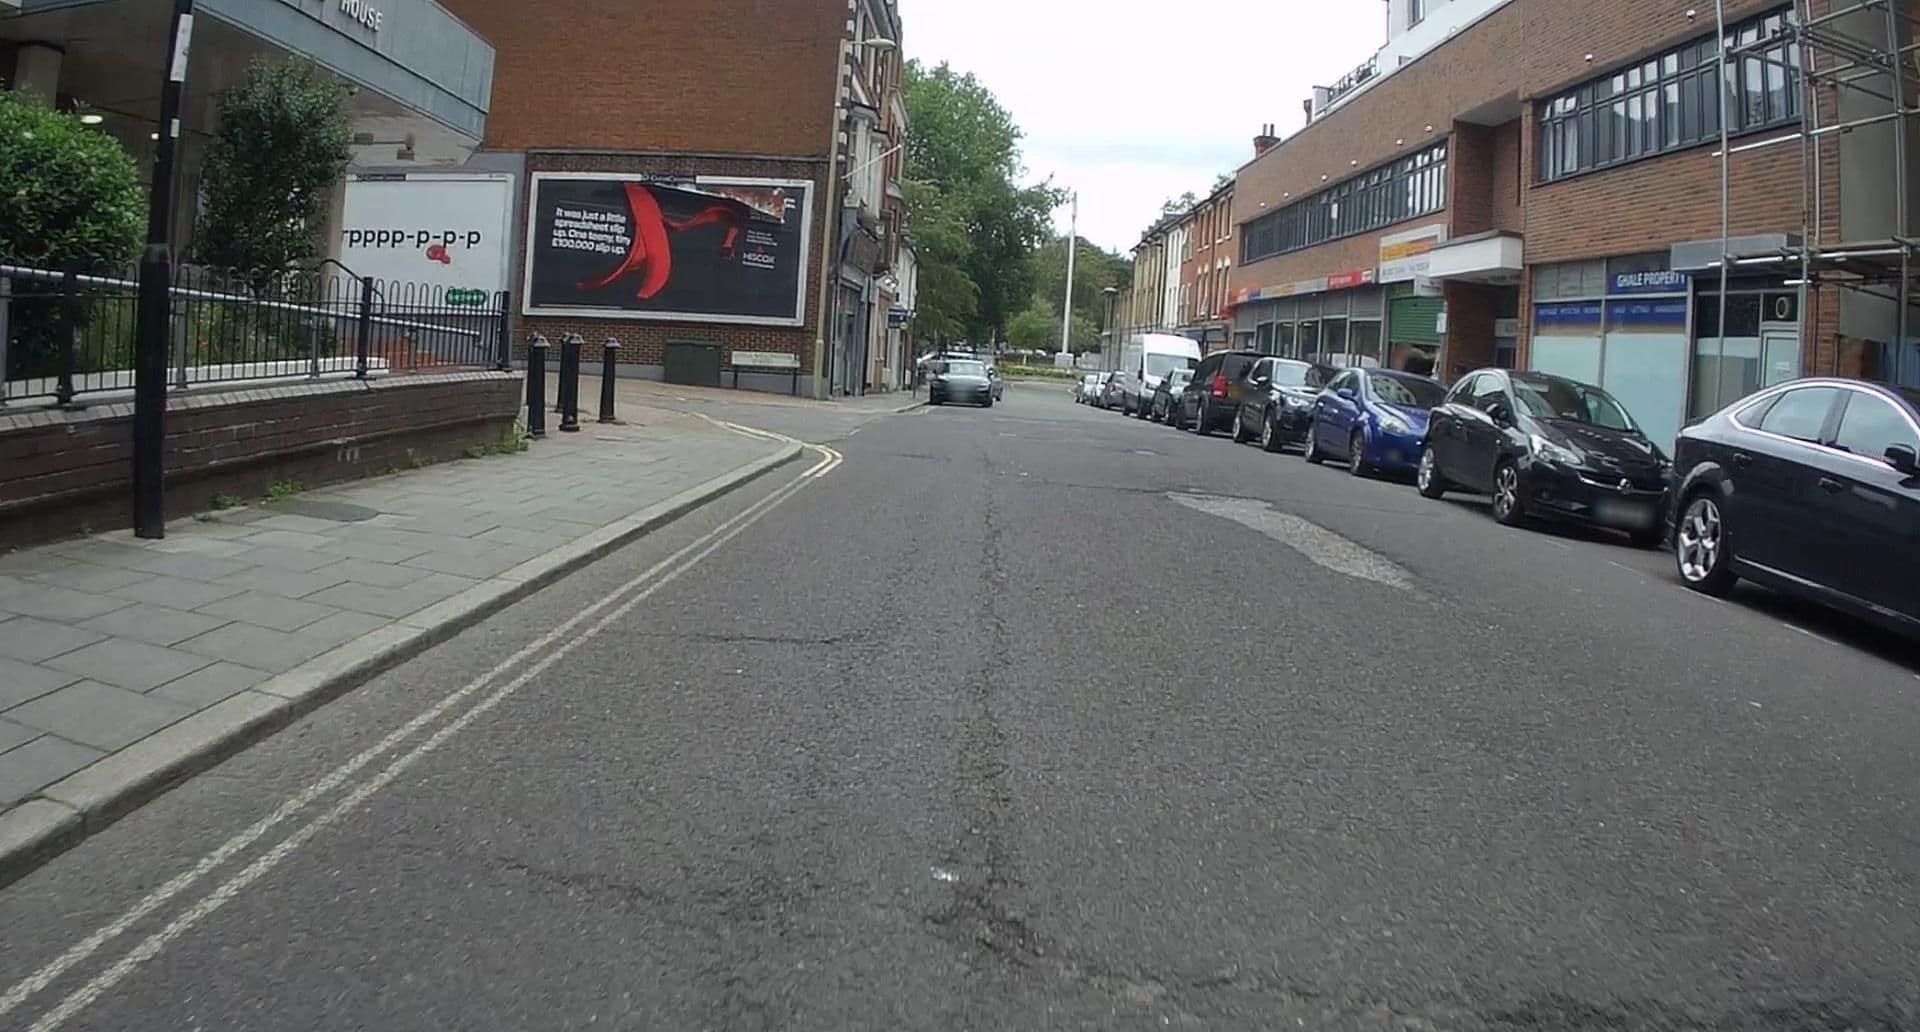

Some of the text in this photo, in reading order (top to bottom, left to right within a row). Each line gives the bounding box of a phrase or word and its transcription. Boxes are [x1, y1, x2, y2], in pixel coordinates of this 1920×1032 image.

[341, 0, 383, 31] HOUSE
[556, 208, 563, 216] It
[564, 210, 582, 218] was
[582, 210, 598, 220] just
[607, 212, 626, 224] little
[554, 220, 625, 234] spreadsheet slip
[568, 229, 587, 239] One
[595, 242, 610, 254] slip
[1617, 272, 1643, 288] GHALE
